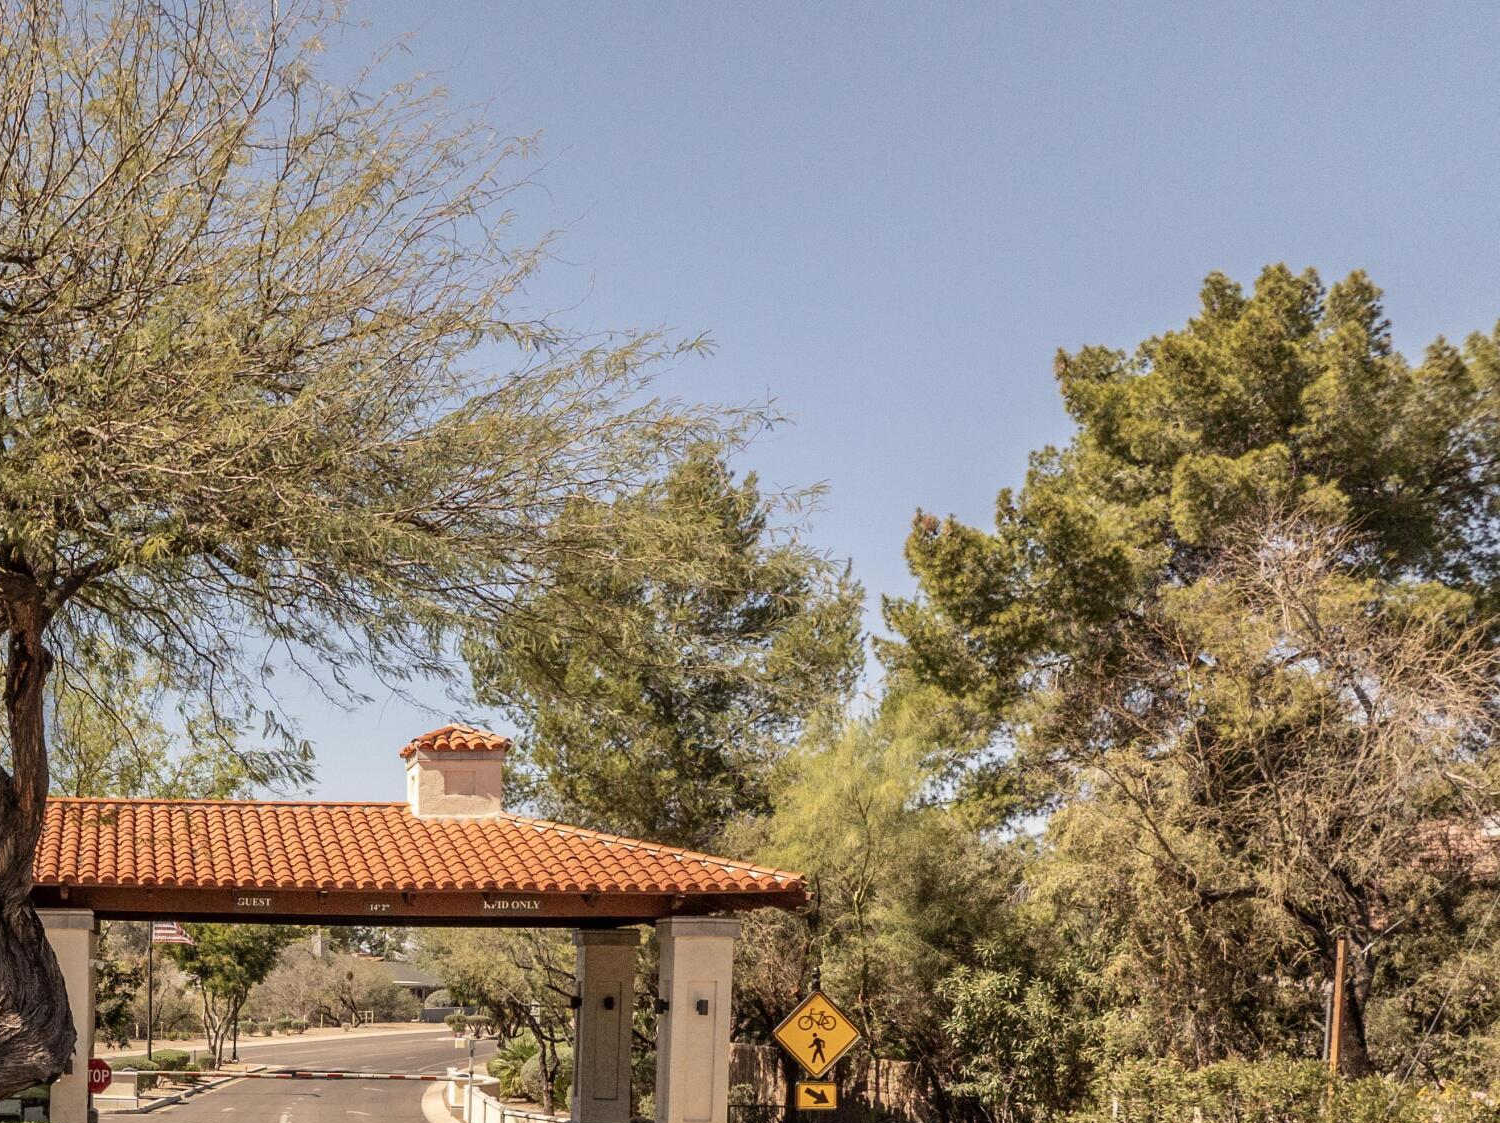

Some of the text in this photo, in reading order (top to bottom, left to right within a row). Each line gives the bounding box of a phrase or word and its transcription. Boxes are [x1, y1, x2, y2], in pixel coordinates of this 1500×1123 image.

[237, 897, 272, 907] GUEST
[511, 900, 540, 909] ONLY
[88, 1069, 110, 1083] TOP
